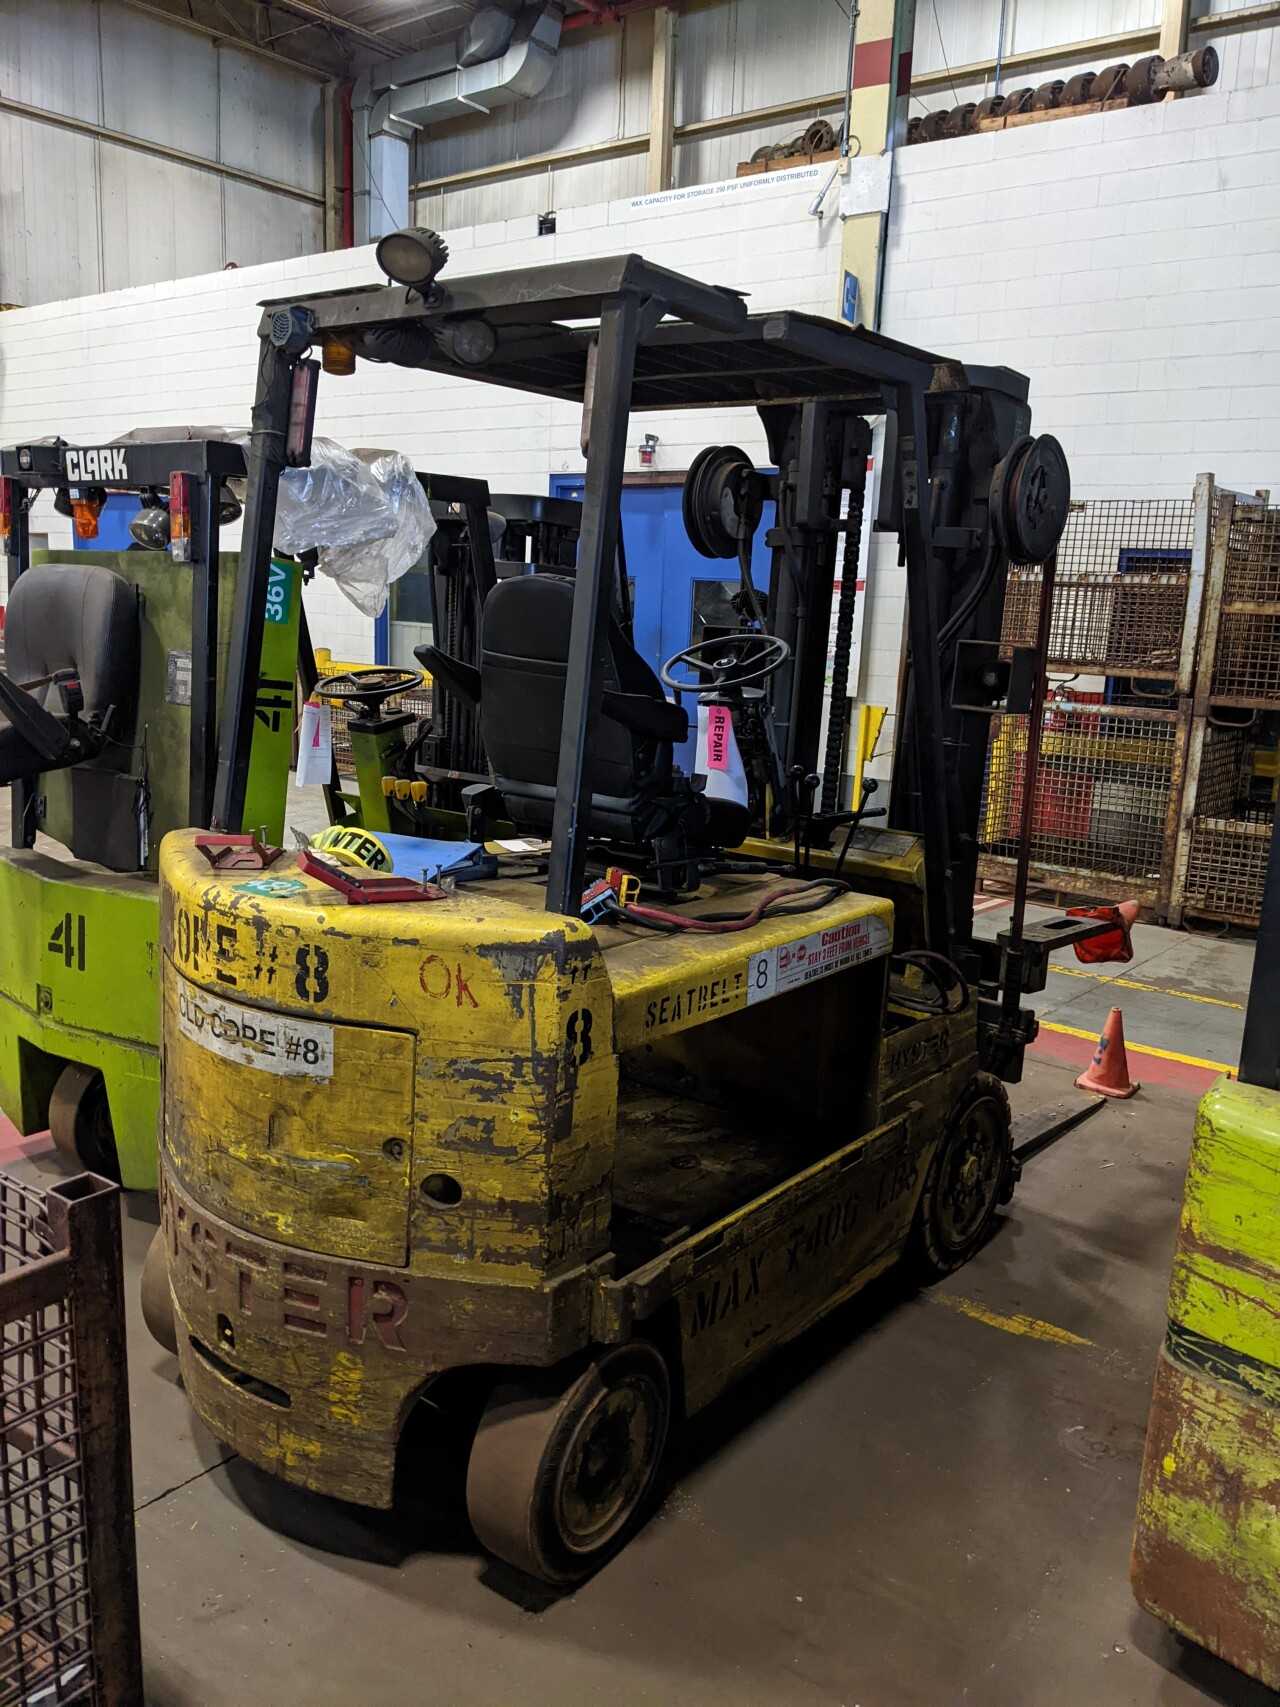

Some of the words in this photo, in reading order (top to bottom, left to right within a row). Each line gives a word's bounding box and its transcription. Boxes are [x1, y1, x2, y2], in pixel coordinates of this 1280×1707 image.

[644, 195, 673, 206] CAPACITY
[673, 193, 686, 201] FOR
[687, 188, 714, 199] STORAGE
[740, 177, 775, 189] UNIFORMLY
[776, 169, 819, 183] DISTRIBUTED
[66, 448, 128, 481] CLARK
[265, 563, 286, 621] 36V
[713, 715, 726, 762] REPAIR
[48, 912, 86, 972] 41
[807, 952, 822, 966] STAY
[827, 945, 838, 960] FEET
[838, 939, 853, 955] FROM
[821, 923, 861, 946] Caution
[756, 958, 768, 989] 8
[645, 972, 743, 1029] SEATBELT
[286, 1036, 320, 1065] #8
[566, 1008, 593, 1066] 8
[691, 1251, 765, 1338] MAX
